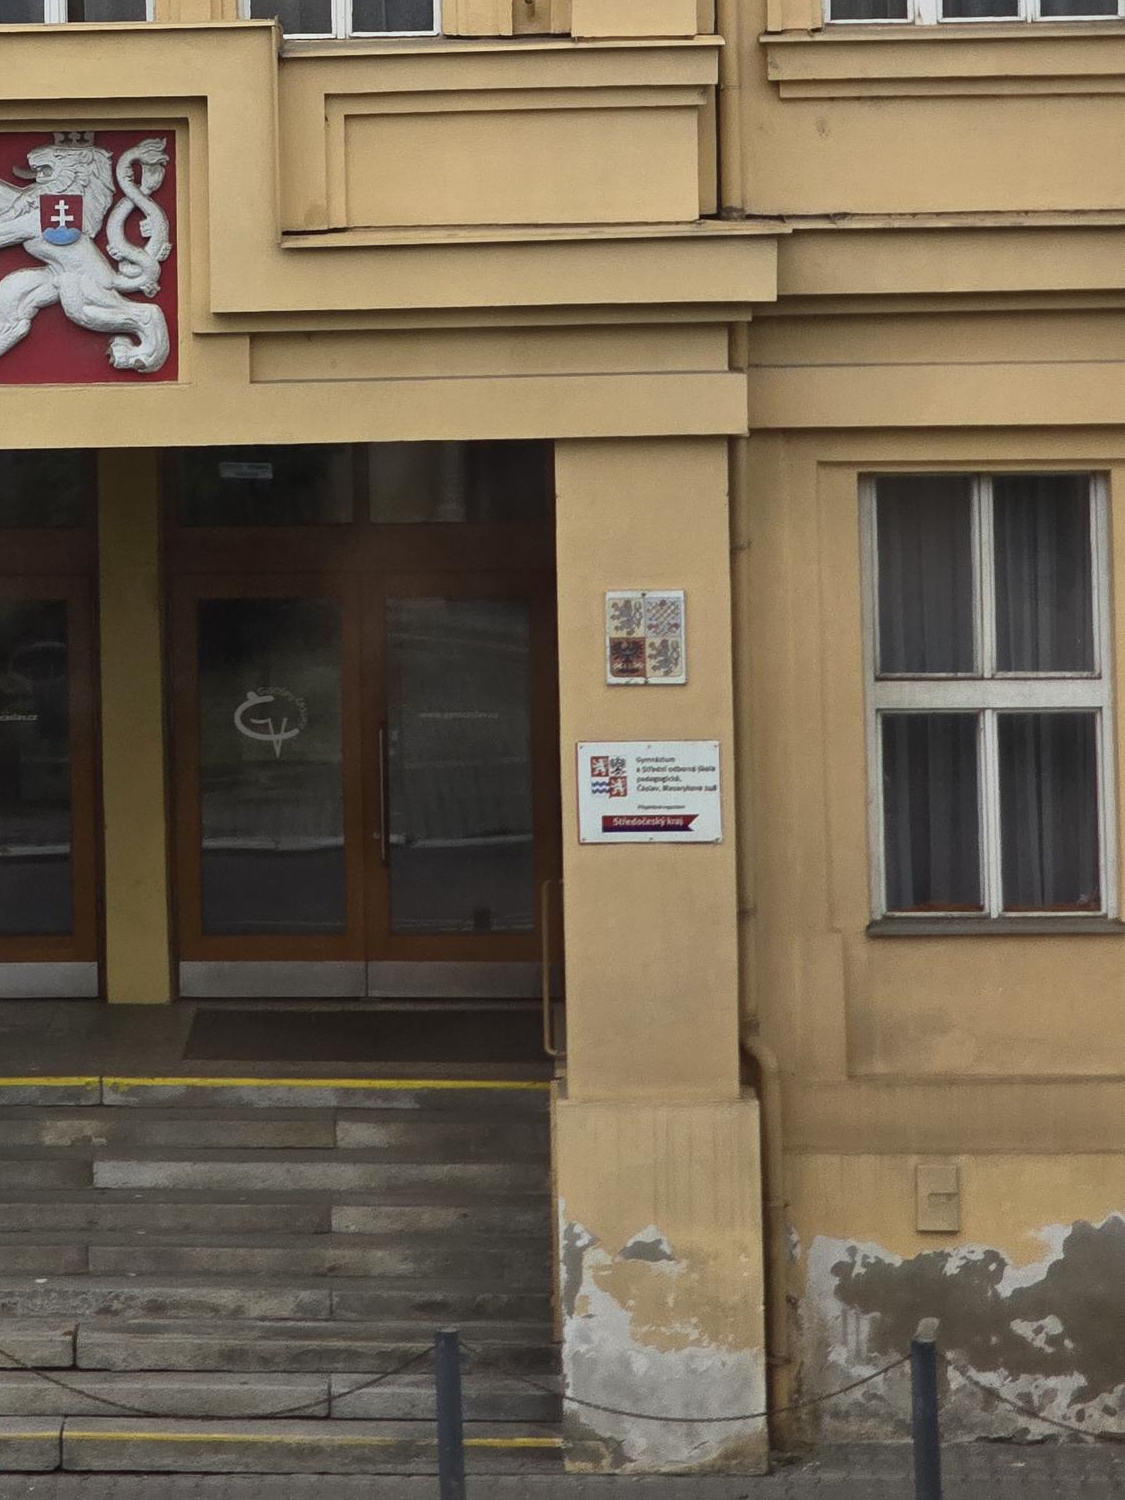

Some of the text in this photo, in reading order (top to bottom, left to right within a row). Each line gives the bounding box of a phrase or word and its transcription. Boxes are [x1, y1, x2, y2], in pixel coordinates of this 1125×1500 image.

[636, 756, 676, 764] Gymnázium
[642, 765, 667, 773] Střední
[668, 765, 696, 773] odborná
[613, 816, 684, 827] Středočeský kraj
